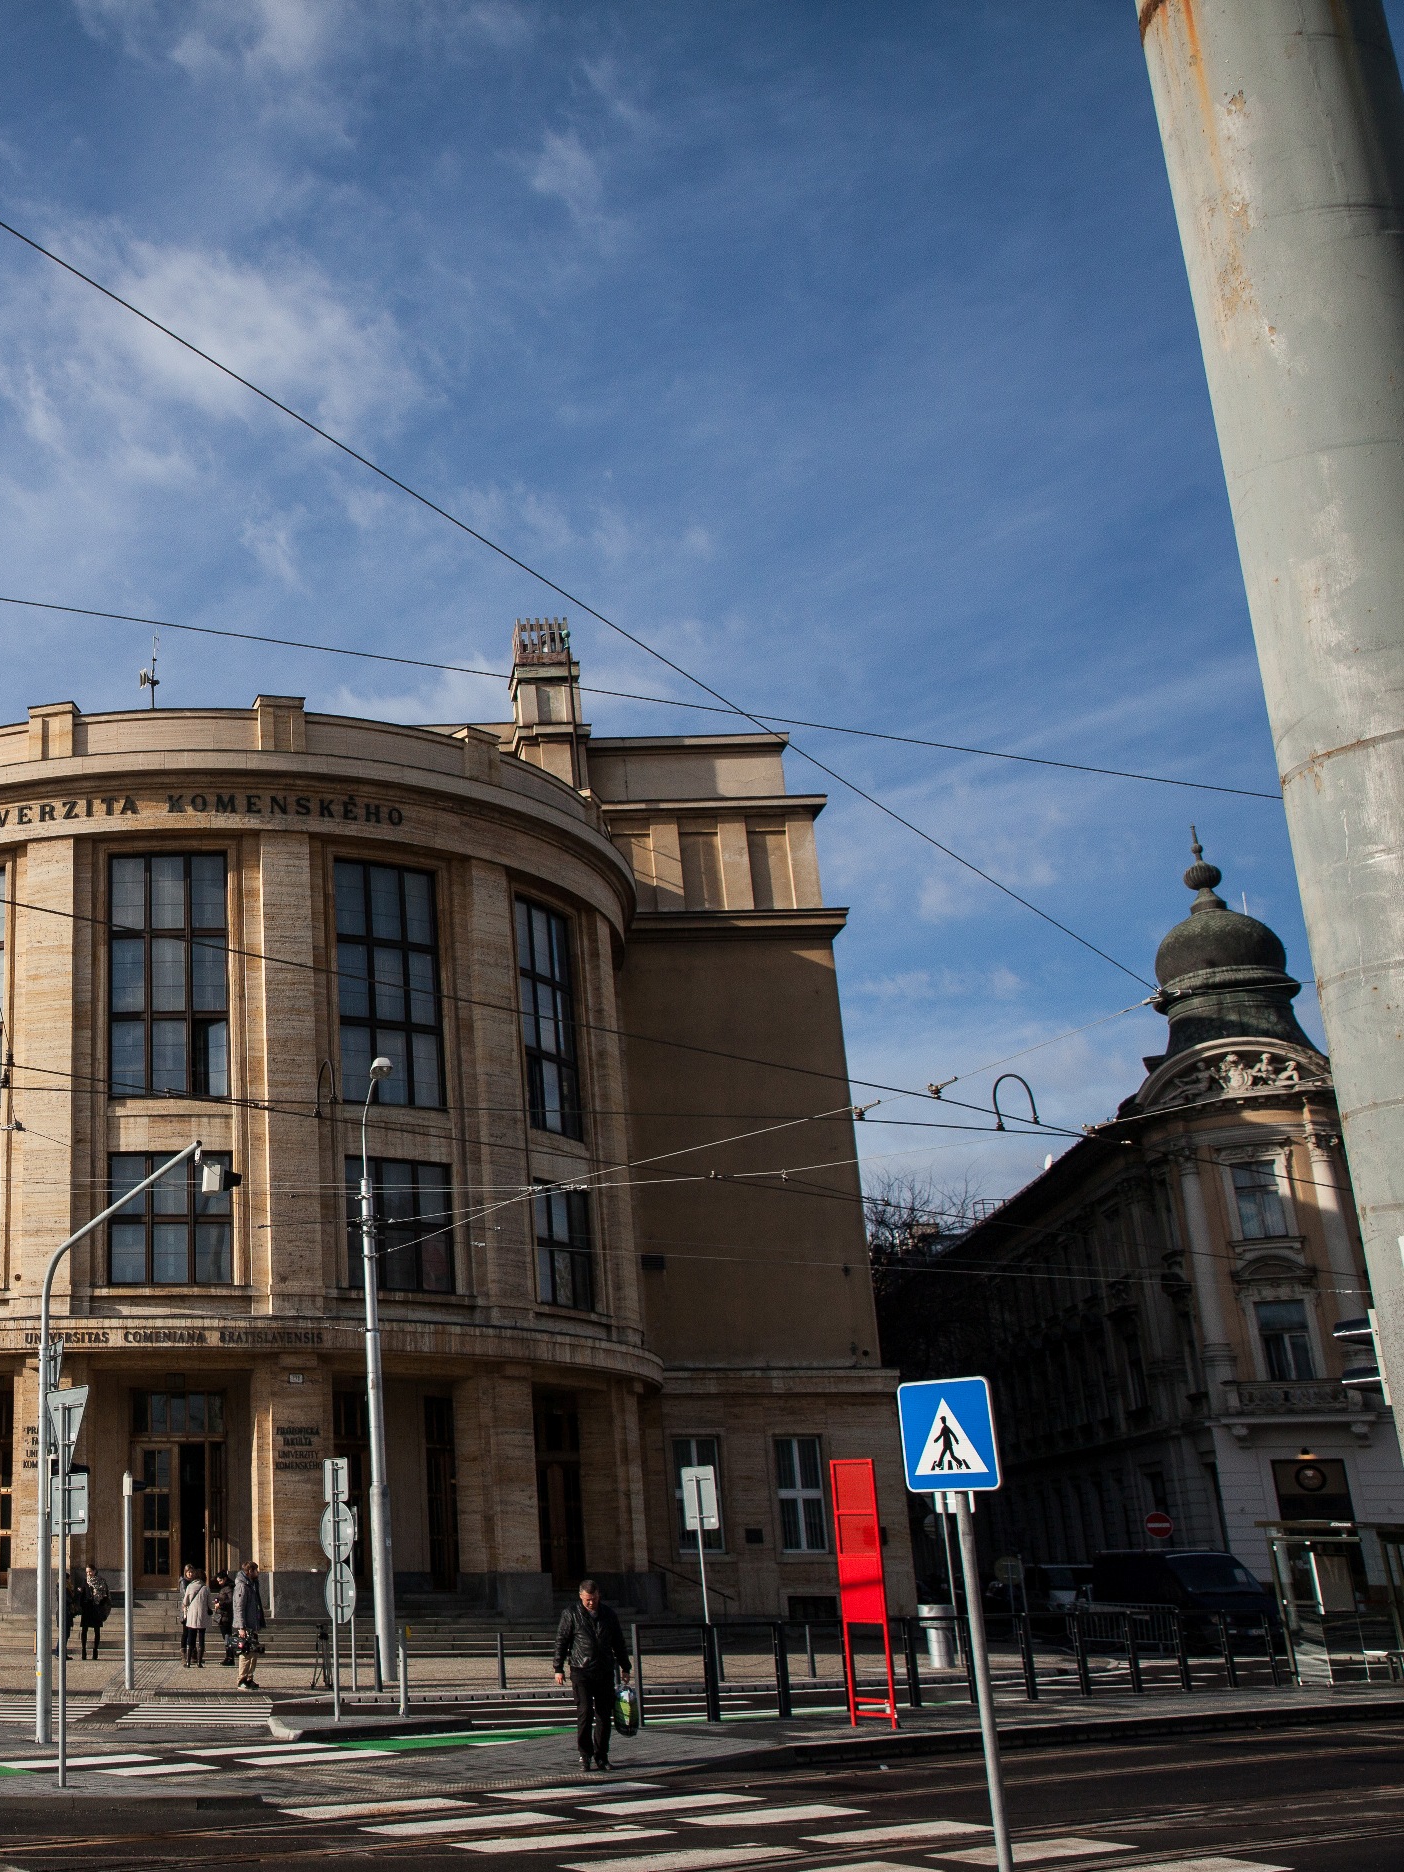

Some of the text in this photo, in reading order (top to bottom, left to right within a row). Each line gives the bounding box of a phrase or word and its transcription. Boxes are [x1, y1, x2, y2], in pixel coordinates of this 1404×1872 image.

[167, 794, 403, 826] KOMENSKÉHO
[25, 1330, 324, 1345] UNVERSITAS COMENIANA BRATISLAVENSIS
[278, 1450, 318, 1459] UNIVERZITY
[276, 1460, 323, 1470] KOMENSKÉHO
